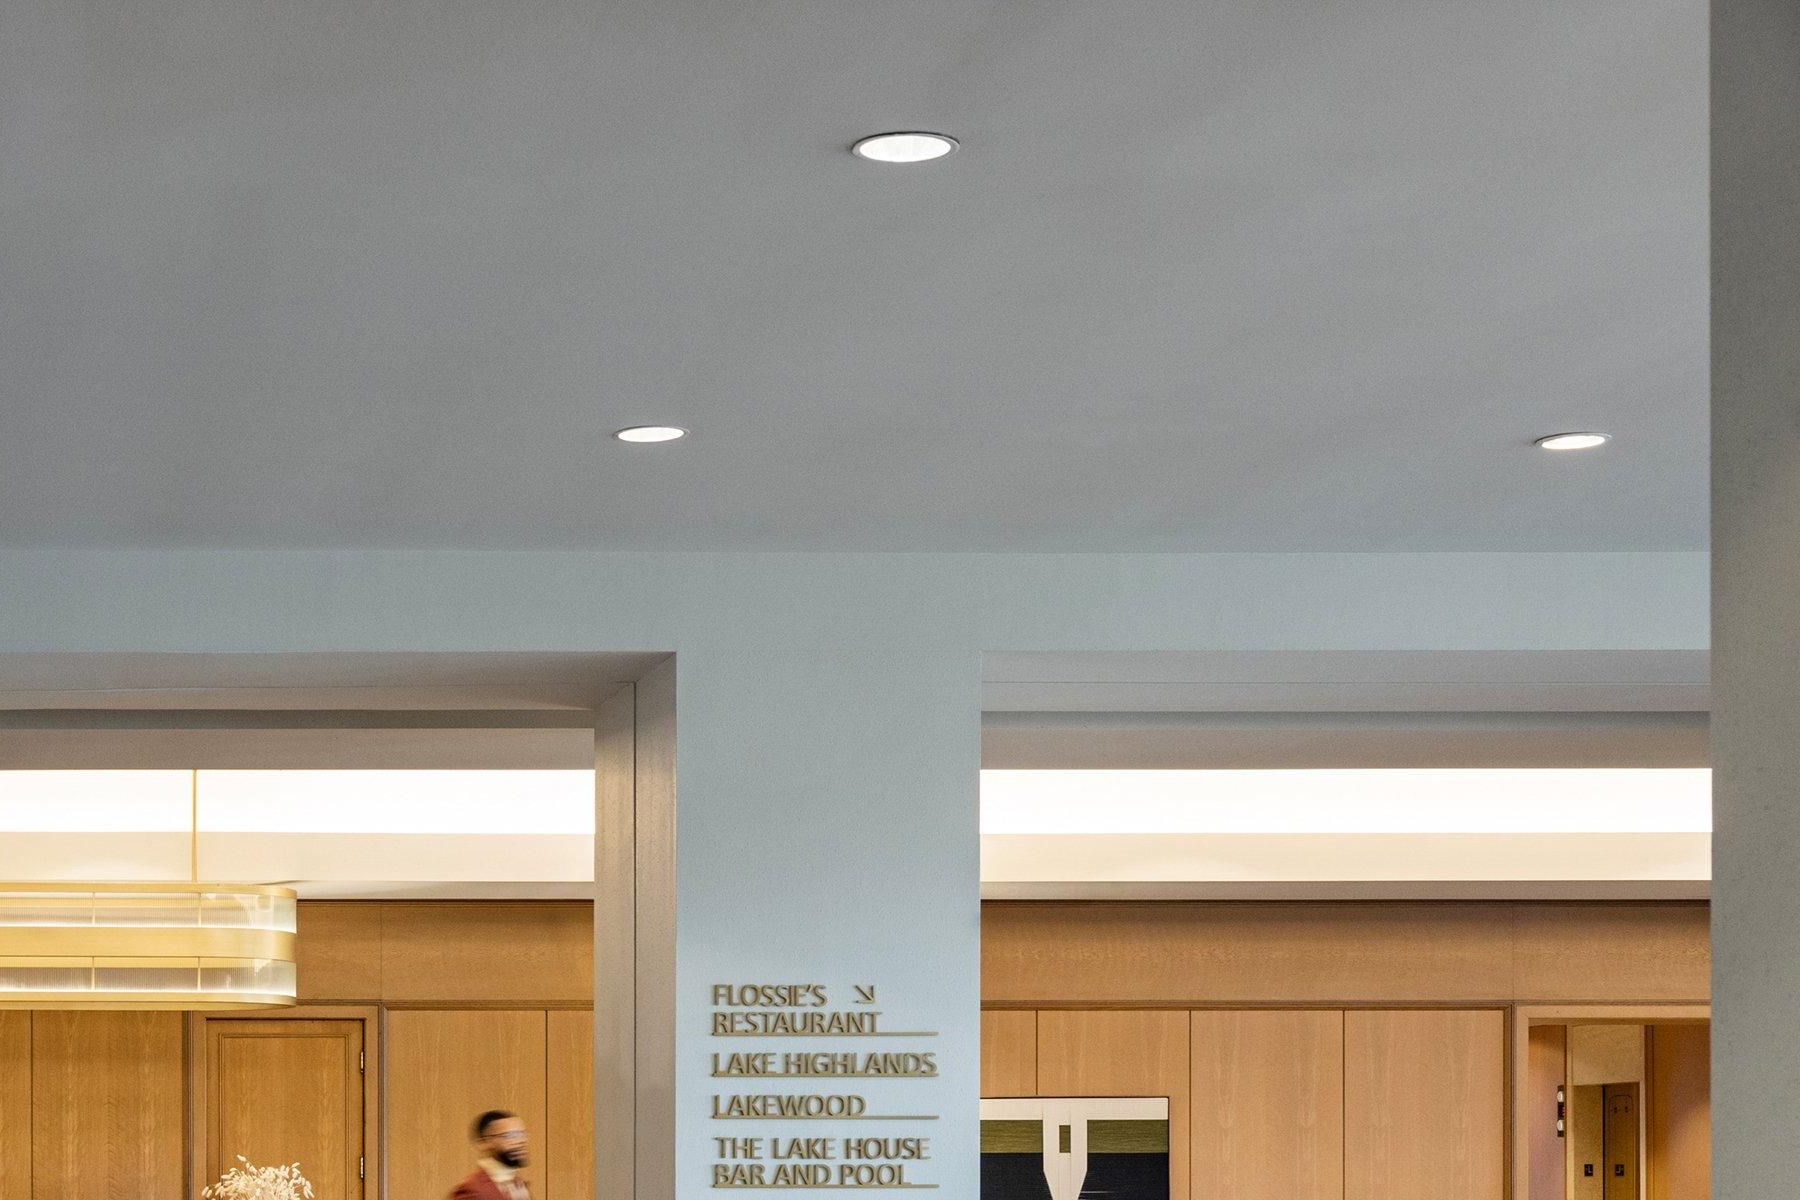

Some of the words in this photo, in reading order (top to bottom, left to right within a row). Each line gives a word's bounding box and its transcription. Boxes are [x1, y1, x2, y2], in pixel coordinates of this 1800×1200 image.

[713, 984, 827, 1006] FLOSSIE'S
[713, 1012, 881, 1033] RESTAURANT
[713, 1052, 776, 1074] LAKE
[785, 1052, 937, 1074] HIGHLANDS
[713, 1095, 867, 1116] LAKEWOOD
[713, 1137, 762, 1159] THE
[773, 1137, 836, 1159] LAKE
[846, 1137, 931, 1159] HOUSE
[713, 1164, 765, 1185] BAR
[773, 1164, 831, 1185] AND
[839, 1164, 911, 1185] POOL
